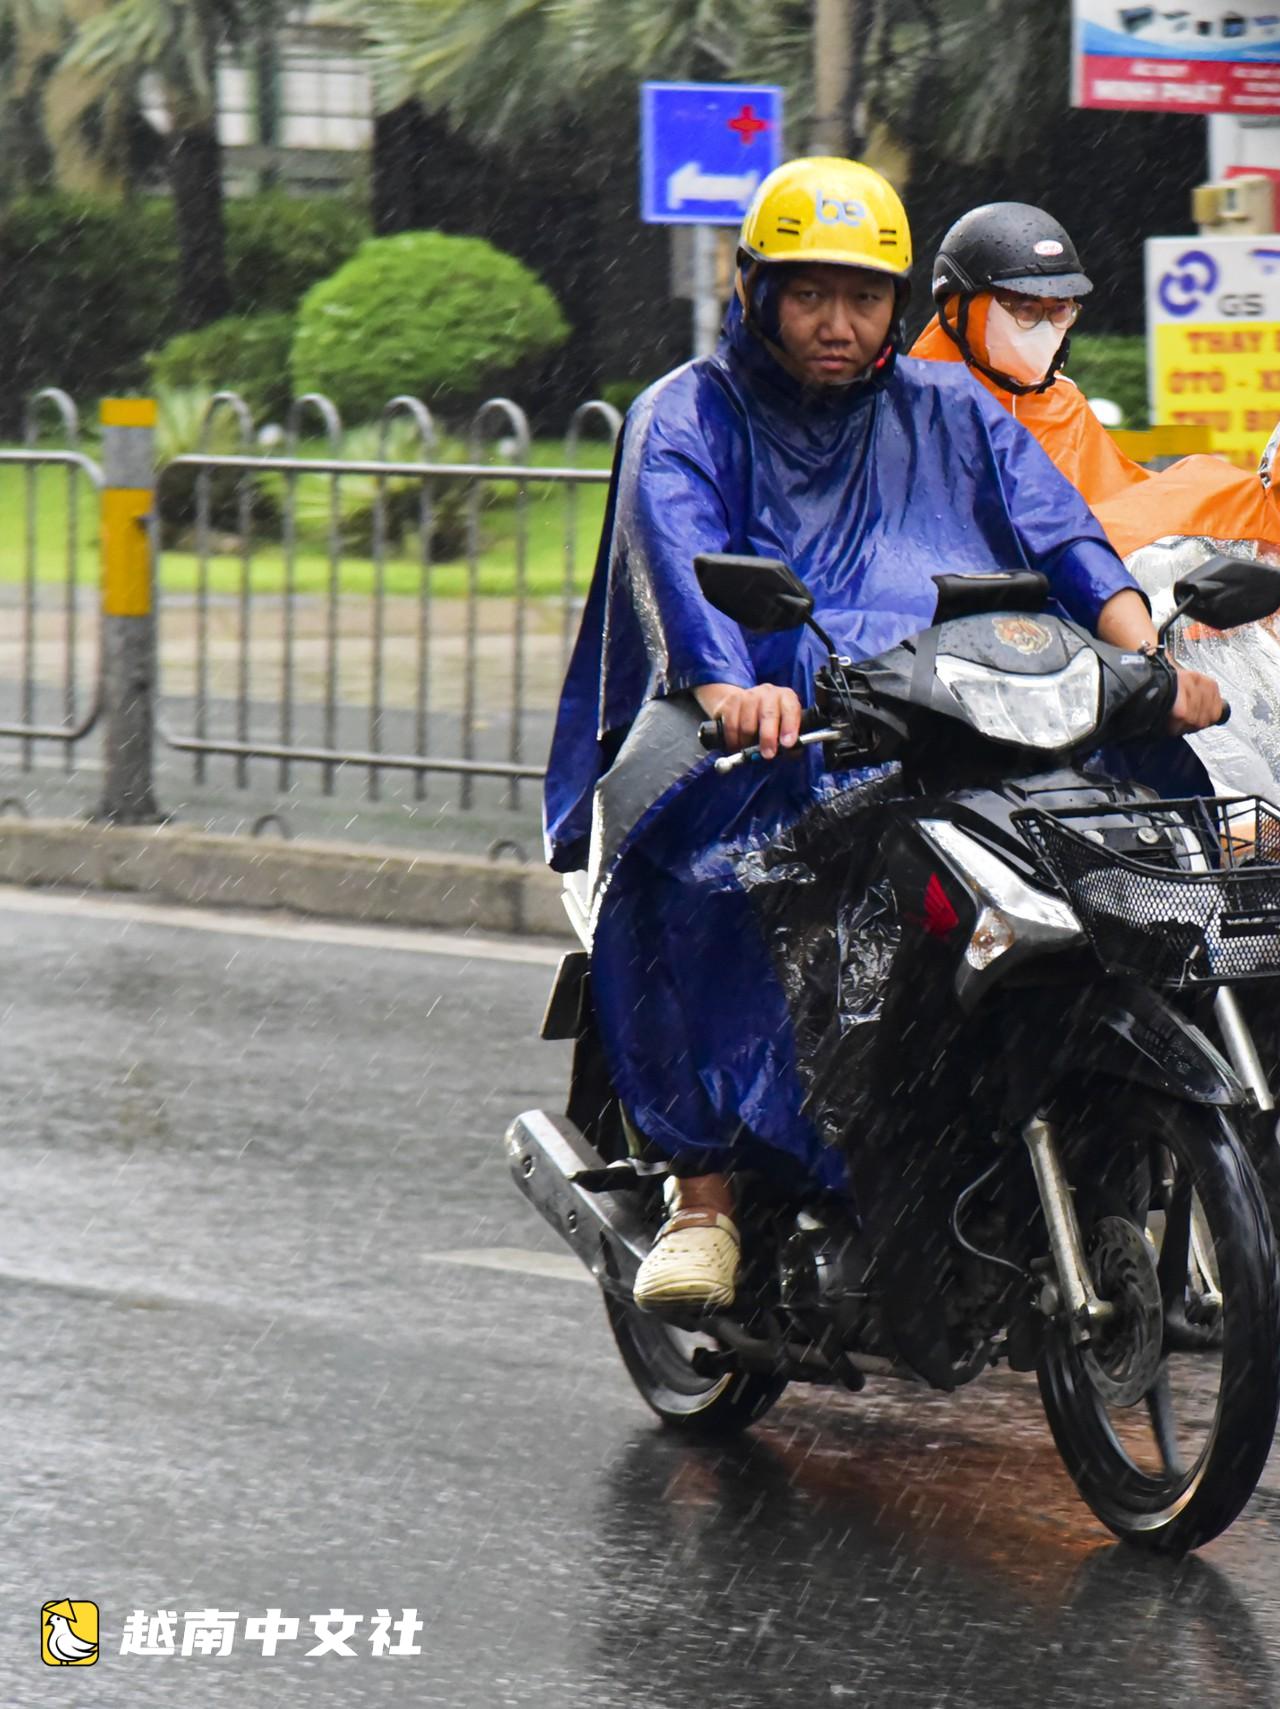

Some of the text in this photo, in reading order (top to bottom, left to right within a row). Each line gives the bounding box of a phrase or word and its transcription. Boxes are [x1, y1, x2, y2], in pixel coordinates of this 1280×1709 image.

[815, 189, 866, 227] be
[1218, 294, 1264, 316] GS
[1186, 331, 1263, 354] THAY
